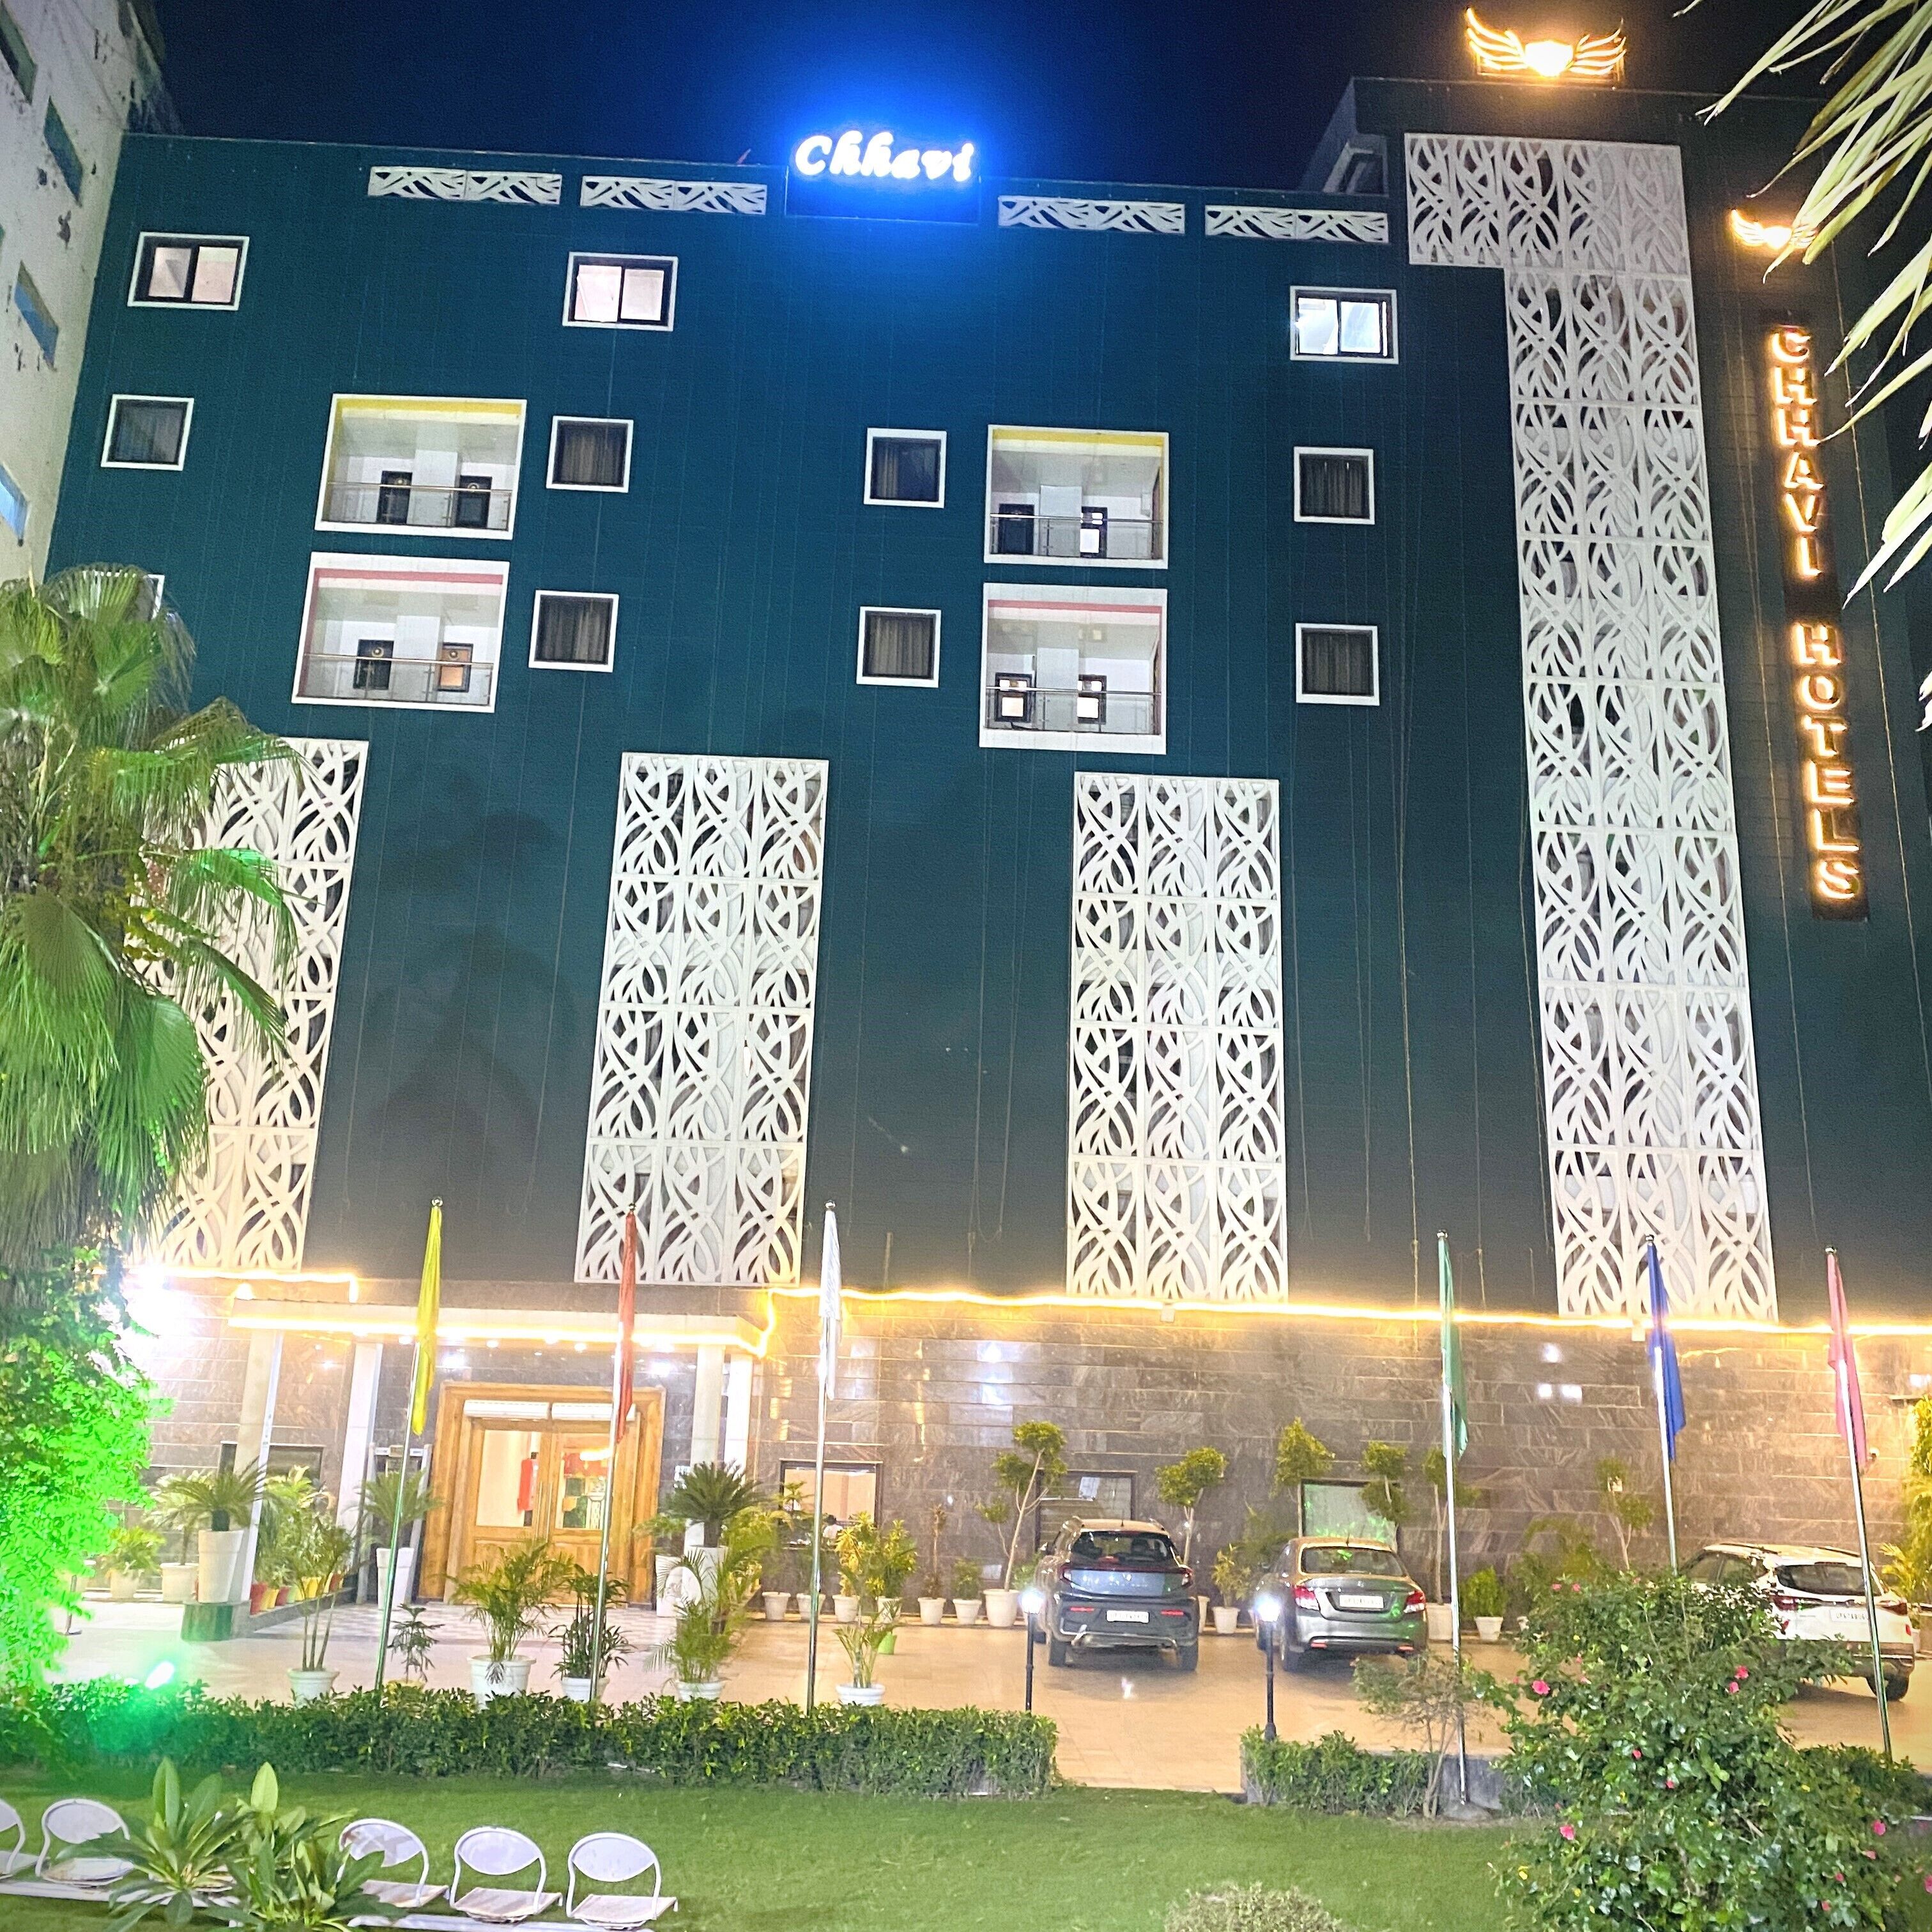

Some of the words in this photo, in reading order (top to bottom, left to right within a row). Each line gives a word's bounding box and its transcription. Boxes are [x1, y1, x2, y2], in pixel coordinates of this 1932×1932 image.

[795, 130, 974, 182] Chhavi
[1770, 325, 1825, 578] CHHAVI
[1793, 622, 1861, 900] HOTELS
